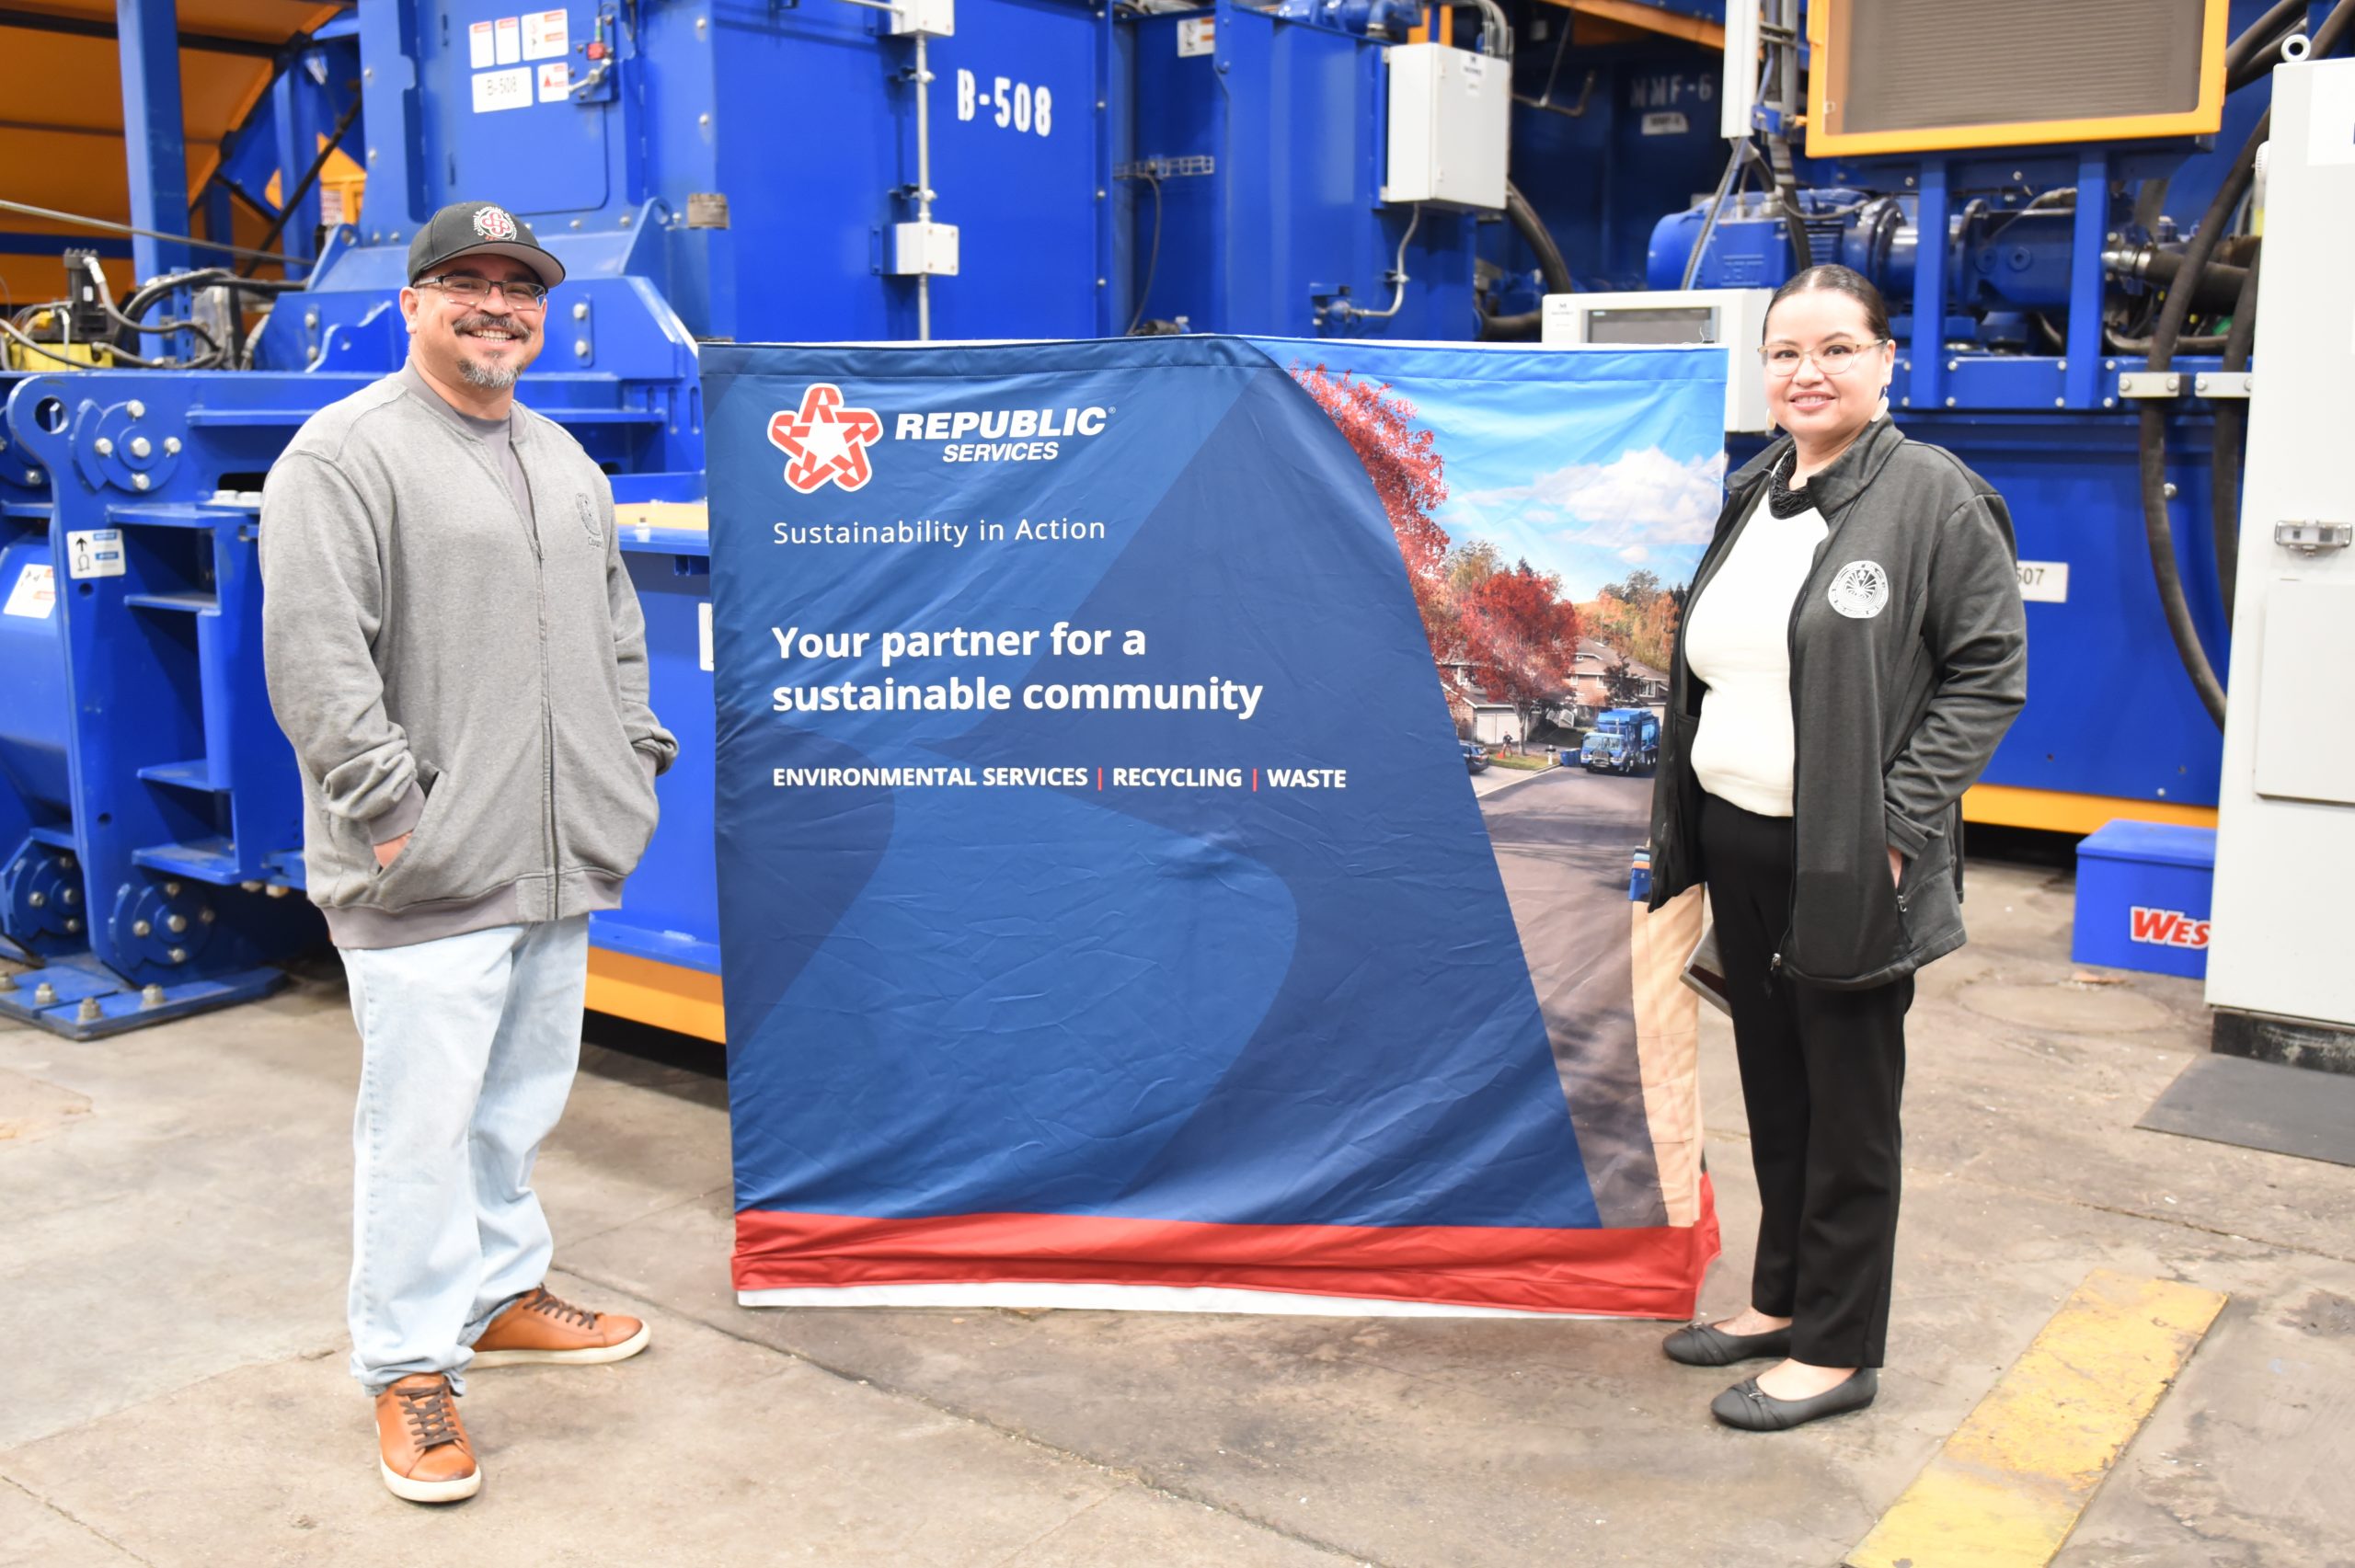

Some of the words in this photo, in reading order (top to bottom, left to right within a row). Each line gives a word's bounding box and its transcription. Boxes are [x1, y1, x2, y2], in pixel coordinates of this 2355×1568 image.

[957, 68, 1051, 137] B-508
[894, 406, 1107, 441] REPUBLIC
[942, 441, 1060, 463] SERVICES
[774, 520, 969, 548] Sustainability
[980, 519, 1005, 541] in
[1014, 517, 1105, 541] Action
[771, 626, 870, 659] Your
[881, 626, 1040, 668] partner
[1050, 621, 1112, 656] for
[1122, 629, 1146, 656] a
[772, 676, 1012, 712] sustainable
[1023, 676, 1264, 720] community
[773, 767, 978, 786] ENVIRONMENTAL
[982, 767, 1088, 786] SERVICES
[1112, 767, 1242, 787] RECYCLING
[1266, 768, 1347, 788] WASTE
